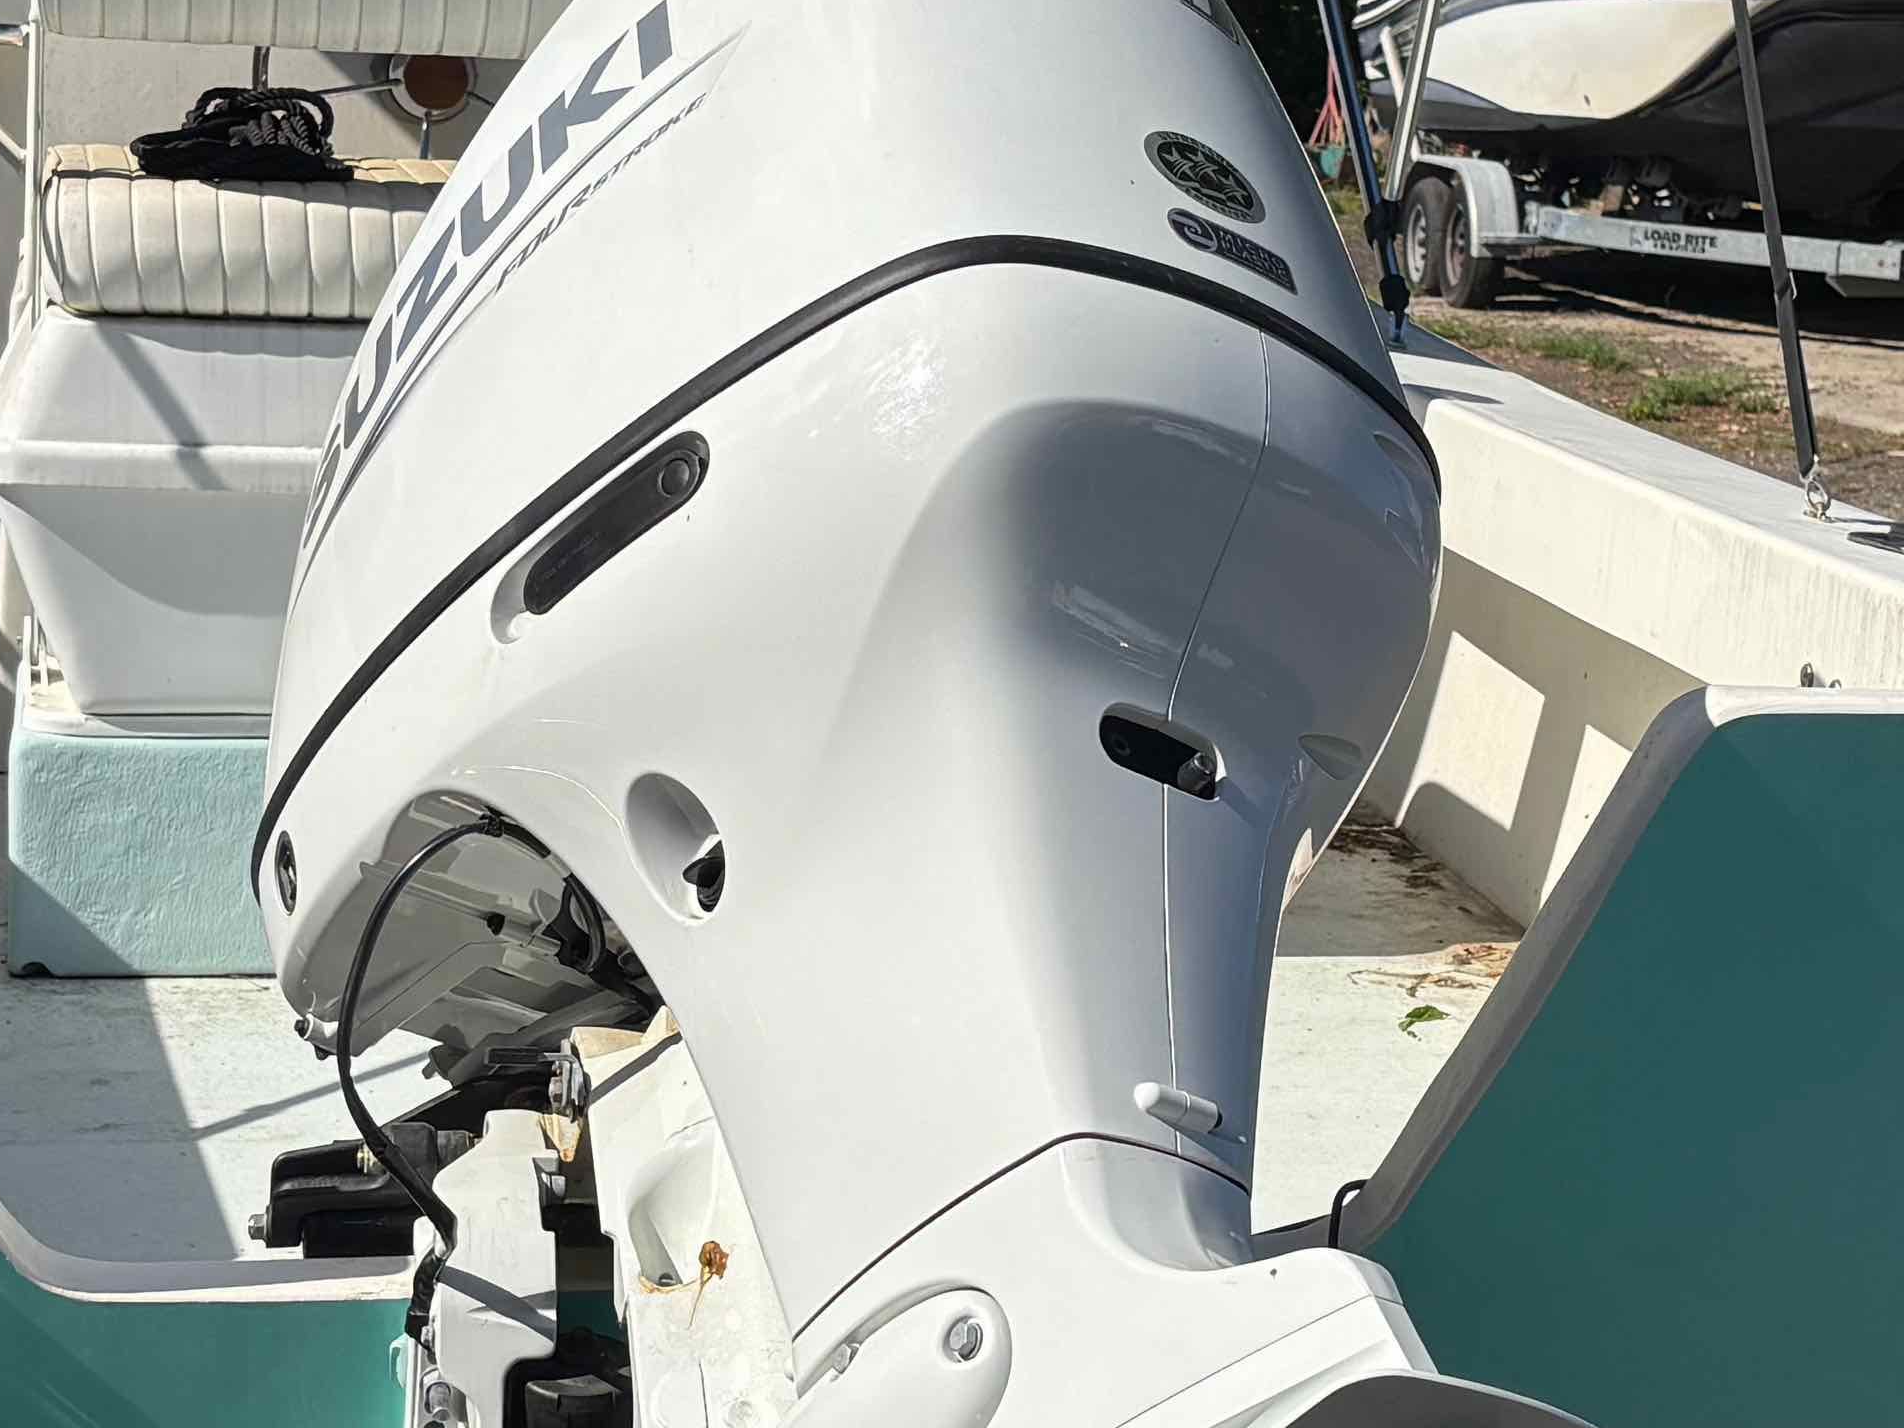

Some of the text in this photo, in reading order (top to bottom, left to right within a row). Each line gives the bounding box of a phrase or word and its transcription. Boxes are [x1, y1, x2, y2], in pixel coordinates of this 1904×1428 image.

[303, 0, 673, 550] SUZUKI
[1643, 228, 1682, 244] LOAD
[1684, 233, 1719, 249] RITE
